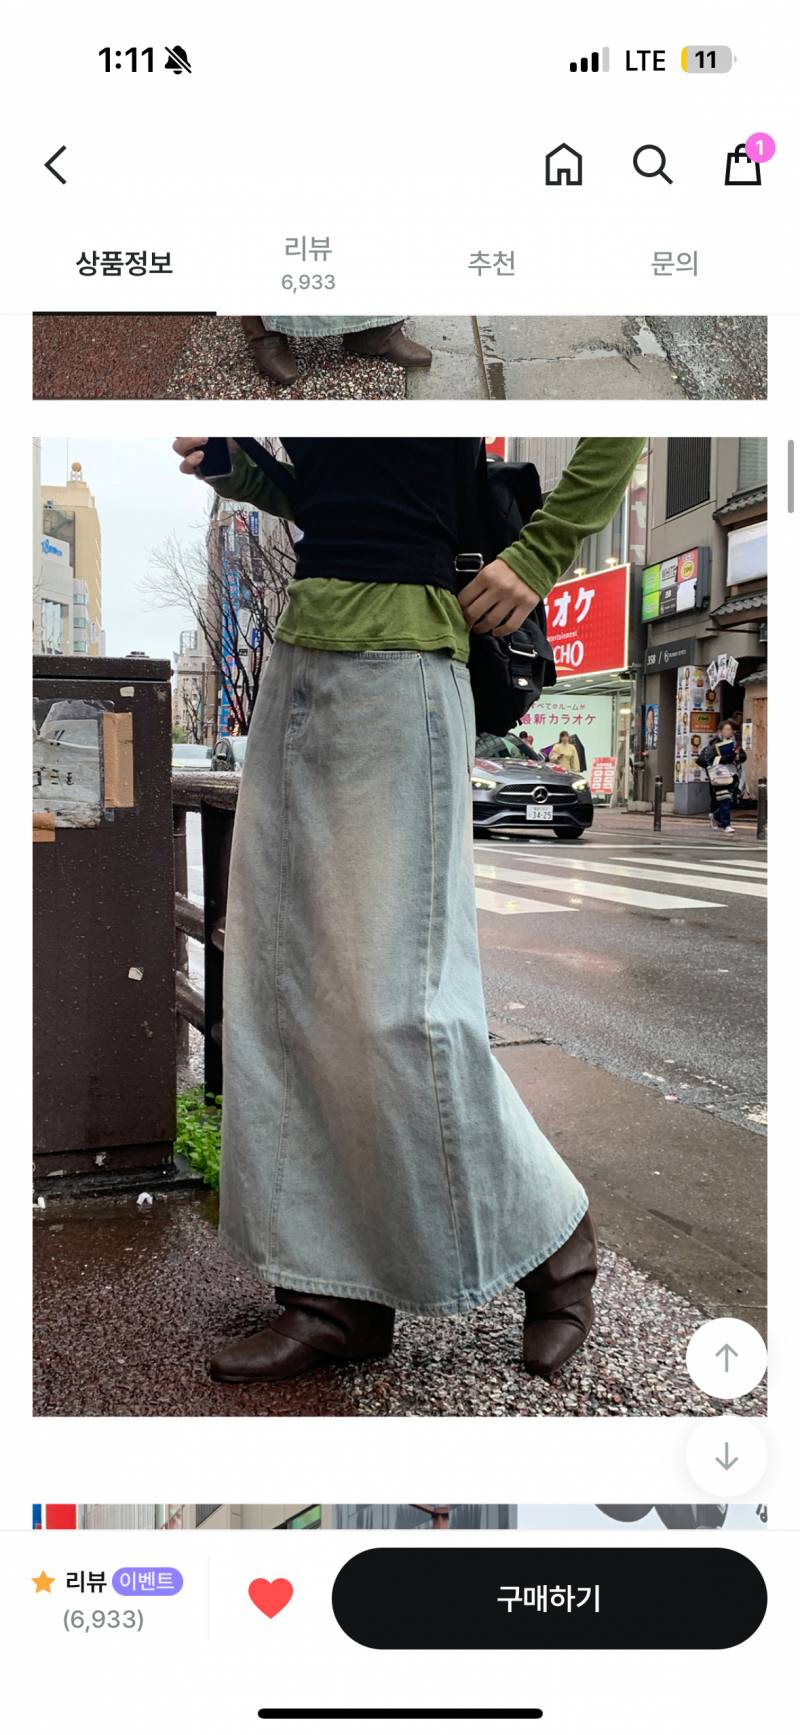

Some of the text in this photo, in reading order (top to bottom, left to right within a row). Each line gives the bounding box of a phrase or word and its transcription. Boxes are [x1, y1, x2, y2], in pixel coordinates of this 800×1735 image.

[98, 47, 154, 73] 1:11
[625, 49, 666, 72] LTE
[694, 50, 717, 69] 11
[755, 139, 765, 156] 1
[284, 236, 333, 262] 리뷰
[75, 250, 174, 277] 상품정보
[467, 250, 517, 277] 추천
[650, 250, 698, 277] 문의
[281, 273, 336, 294] 6,933
[66, 1570, 174, 1594] 리뷰 이벤트
[496, 1584, 601, 1613] 구매하기
[63, 1608, 144, 1633] (6,933)
